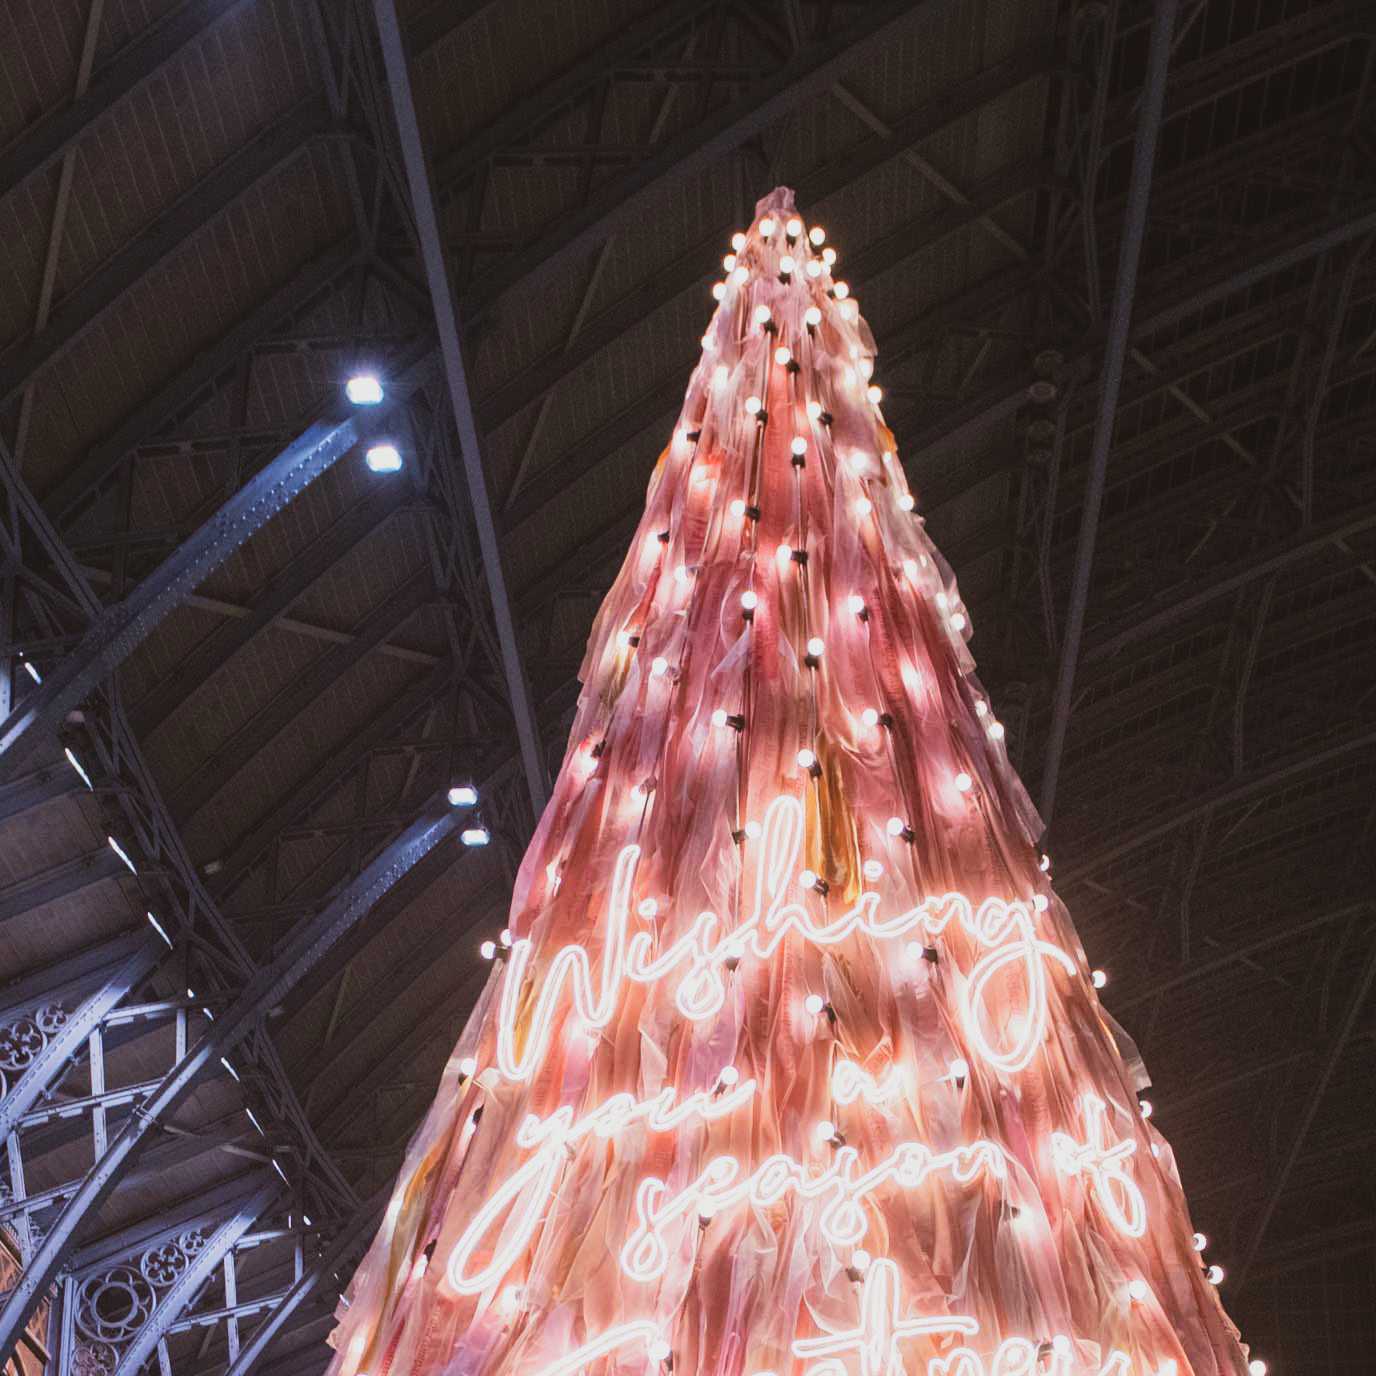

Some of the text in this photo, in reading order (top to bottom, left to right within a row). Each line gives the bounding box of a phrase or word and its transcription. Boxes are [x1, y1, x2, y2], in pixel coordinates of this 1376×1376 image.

[497, 794, 1077, 1081] Wishing
[447, 1059, 905, 1295] you a
[621, 1093, 1139, 1282] season of
